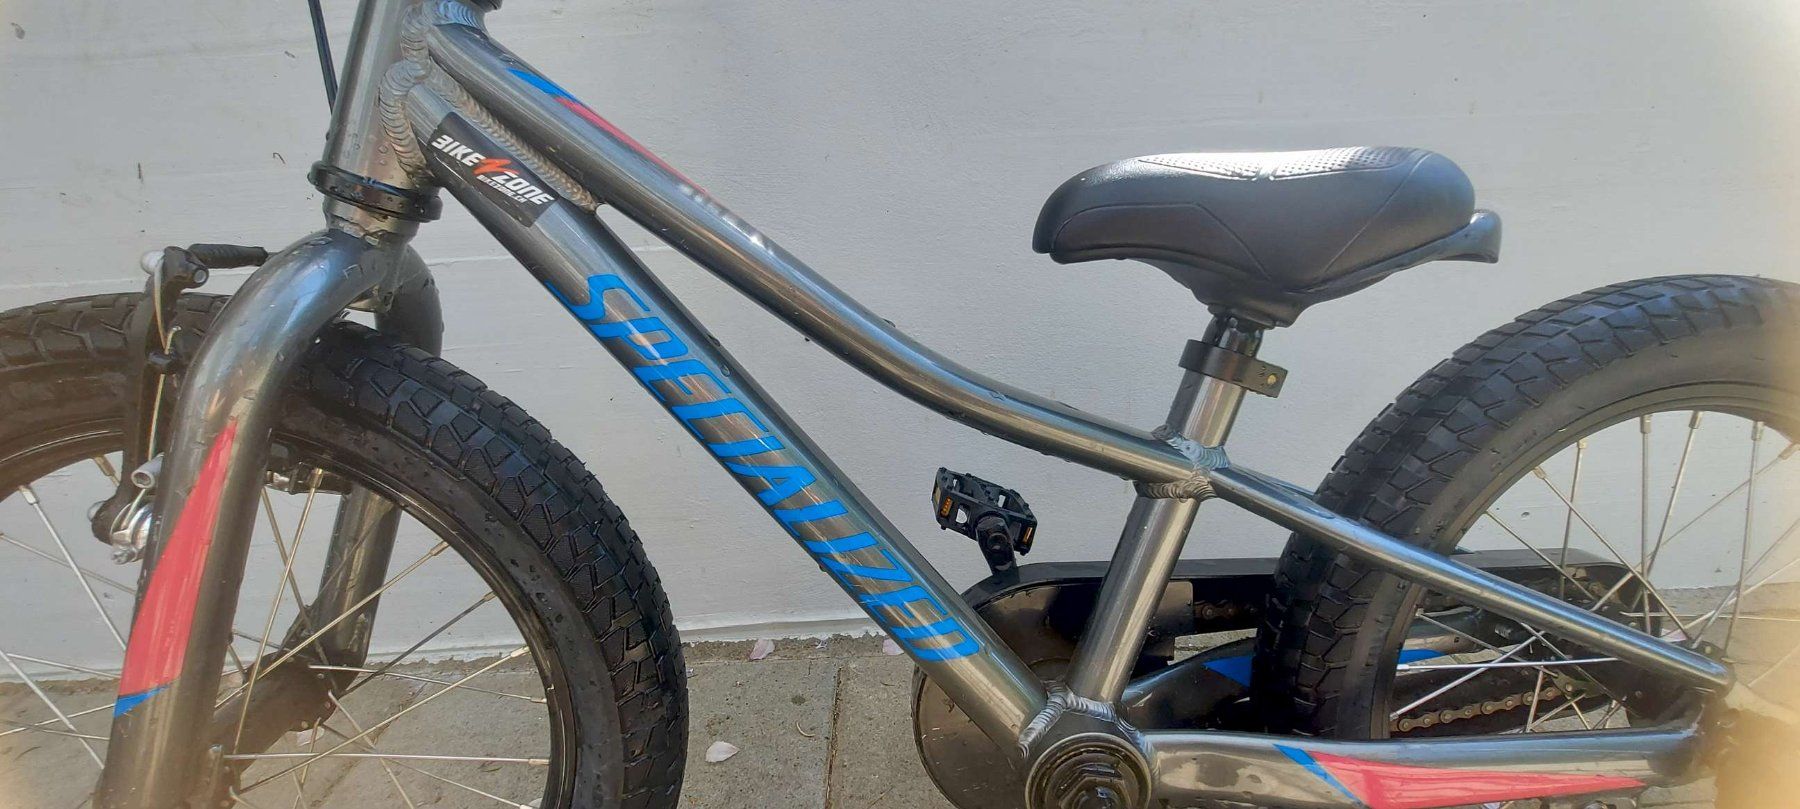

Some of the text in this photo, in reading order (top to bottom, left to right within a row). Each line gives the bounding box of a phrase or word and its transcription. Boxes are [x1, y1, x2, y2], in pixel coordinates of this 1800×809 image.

[431, 134, 556, 205] BIKE ZONE
[545, 273, 980, 663] SPECIALIZED
